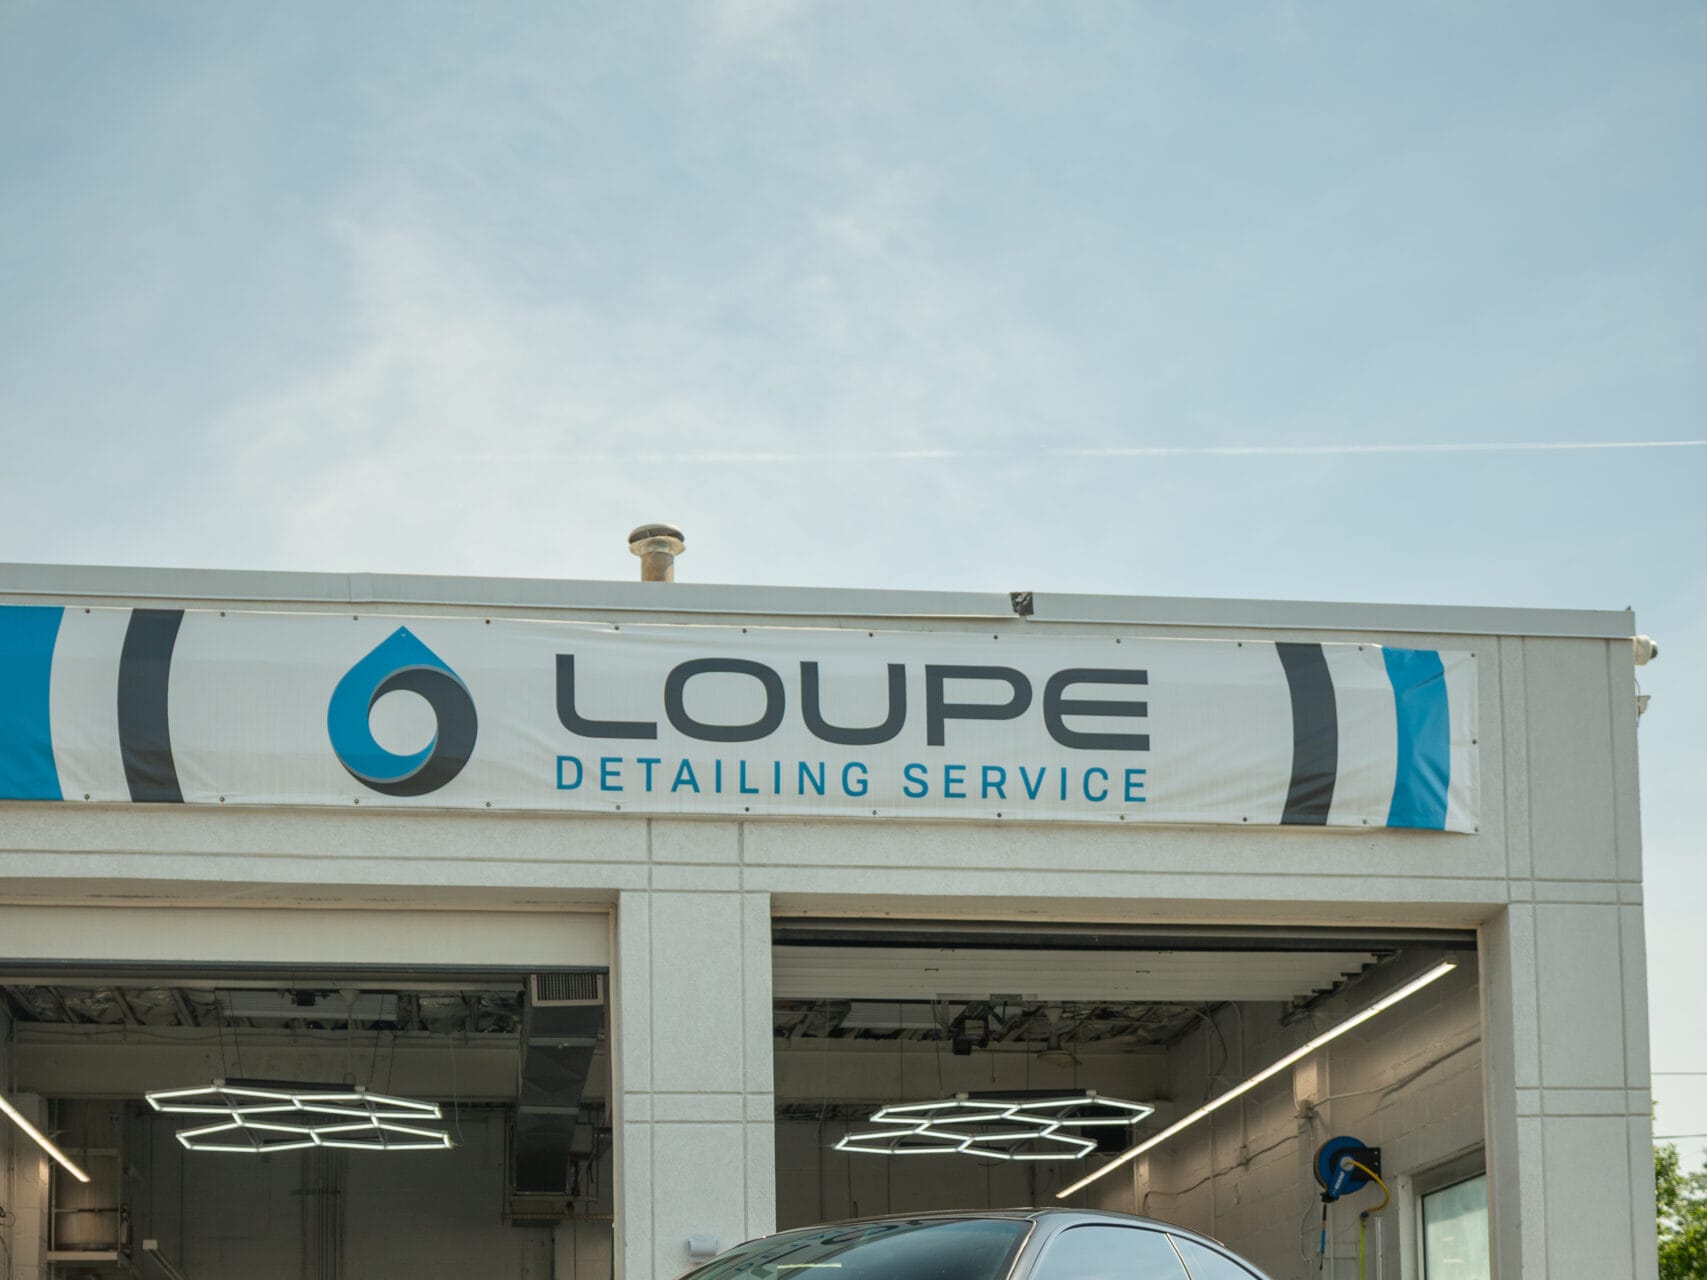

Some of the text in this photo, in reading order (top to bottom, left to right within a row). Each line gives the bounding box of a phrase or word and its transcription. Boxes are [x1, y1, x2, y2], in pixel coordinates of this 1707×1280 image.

[556, 653, 1150, 751] LOUPE
[556, 755, 1148, 802] DETAILING SERVICE
